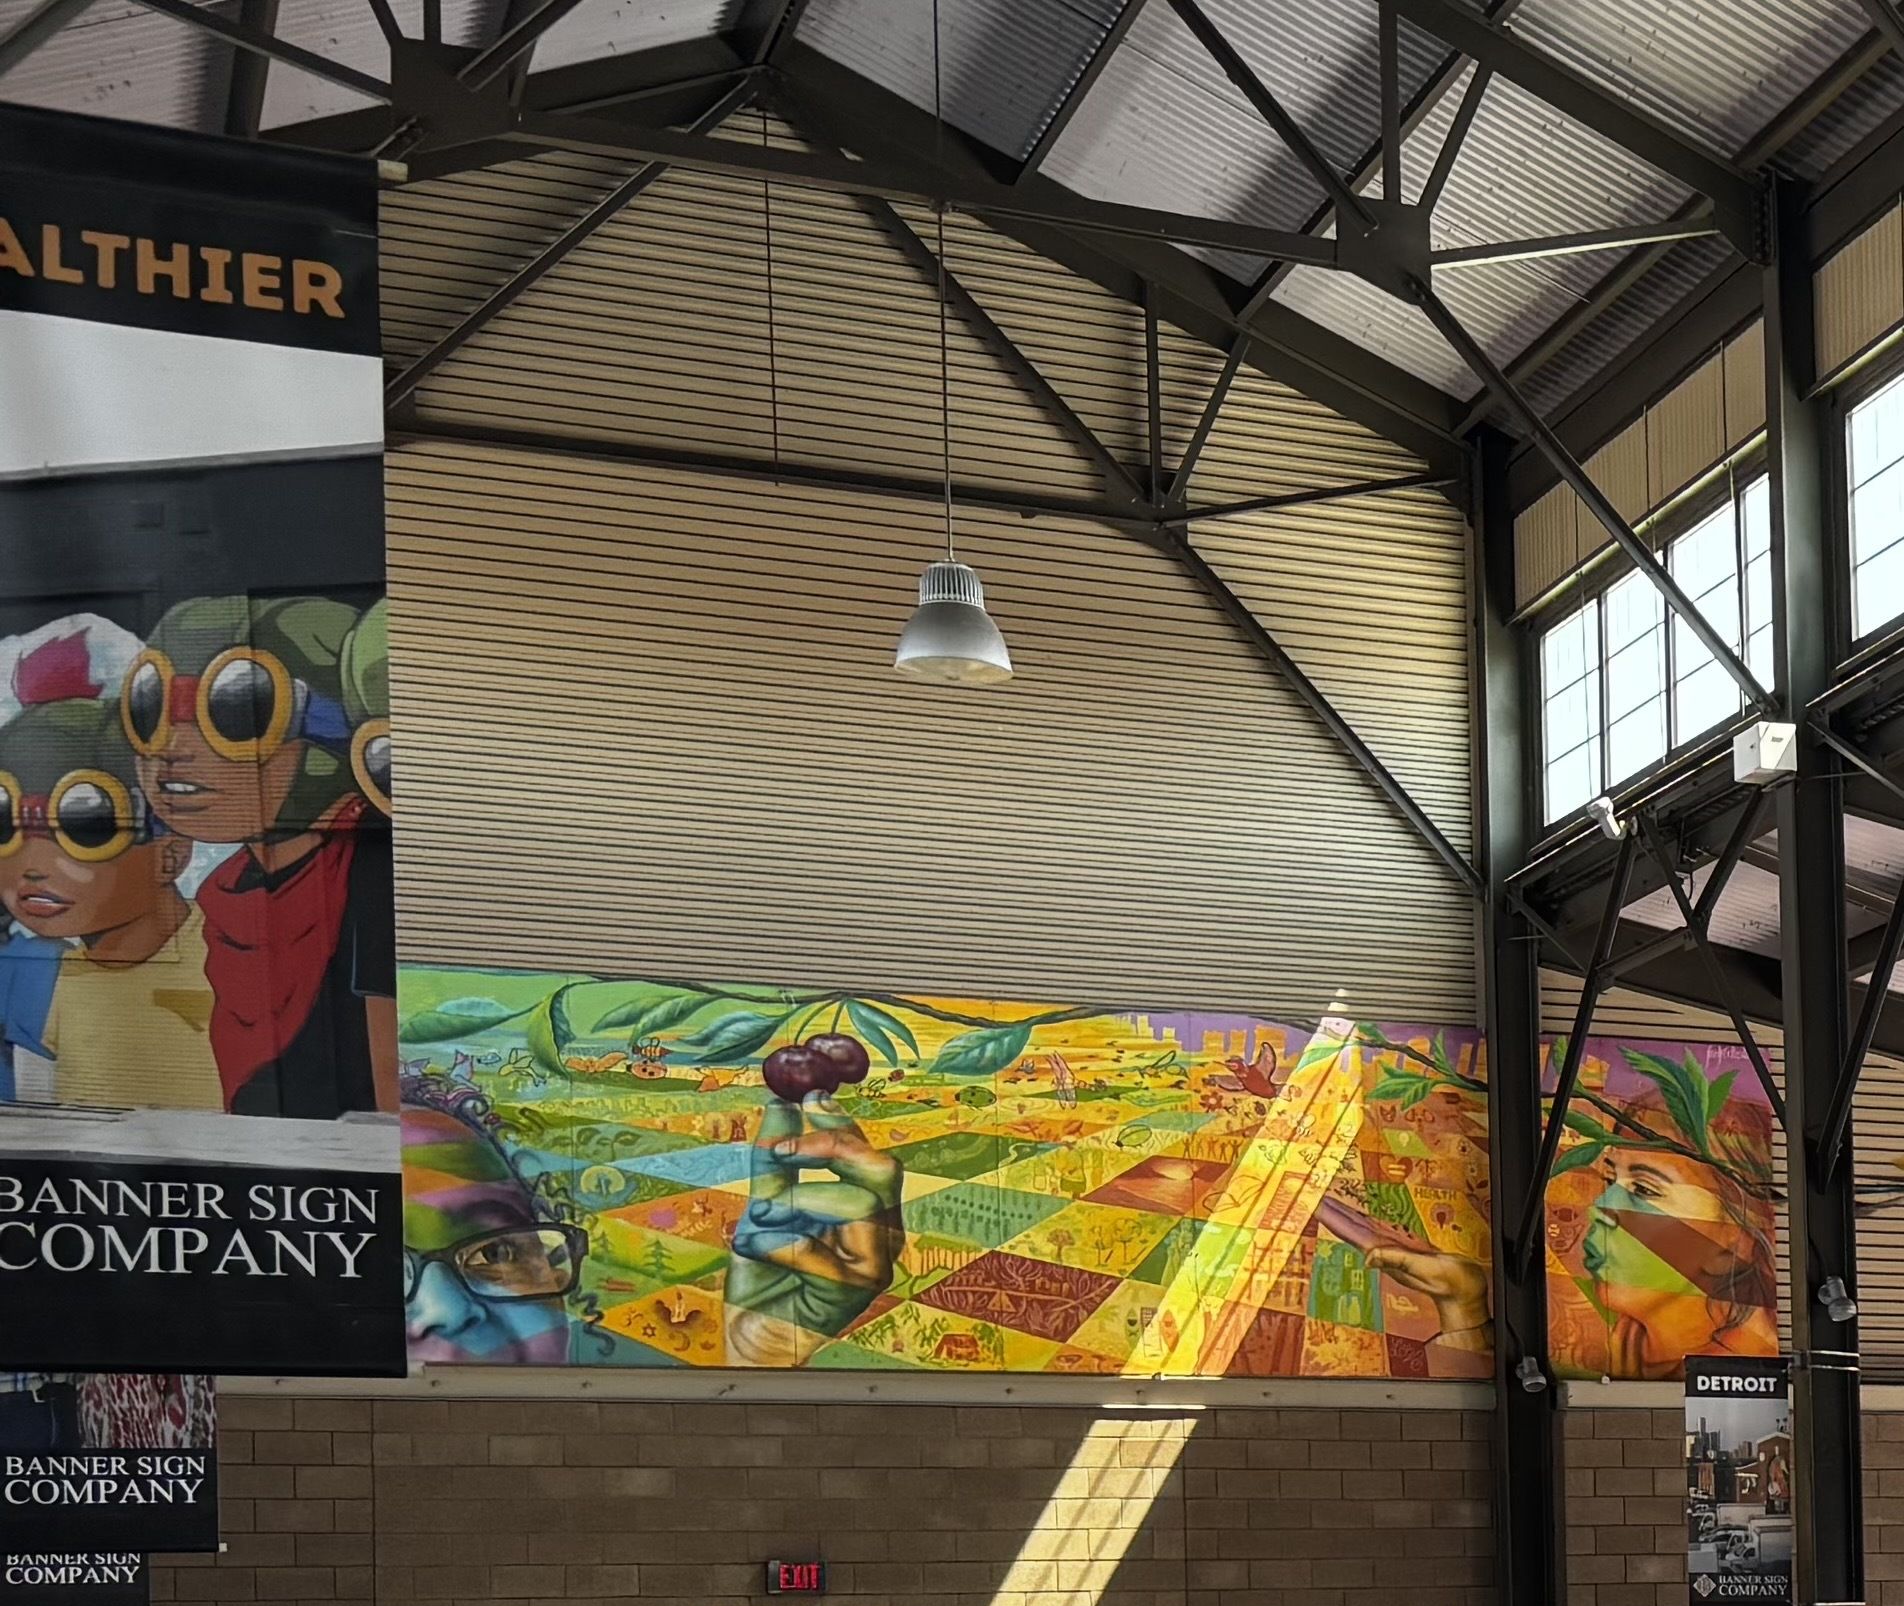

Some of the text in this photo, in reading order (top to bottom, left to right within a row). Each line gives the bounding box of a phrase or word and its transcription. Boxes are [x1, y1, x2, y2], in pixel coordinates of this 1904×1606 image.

[0, 217, 346, 319] ALTHIER
[0, 1176, 379, 1225] BANNER SIGN
[0, 1222, 378, 1278] COMPANY
[1696, 1375, 1778, 1392] DETROIT
[5, 1456, 206, 1477] BANNER SIGN
[4, 1478, 204, 1506] COMPANY
[5, 1566, 141, 1585] COMPANY
[779, 1563, 821, 1590] EXIT
[1719, 1574, 1789, 1585] BANNER SIGN
[1719, 1584, 1788, 1597] COMPANY
